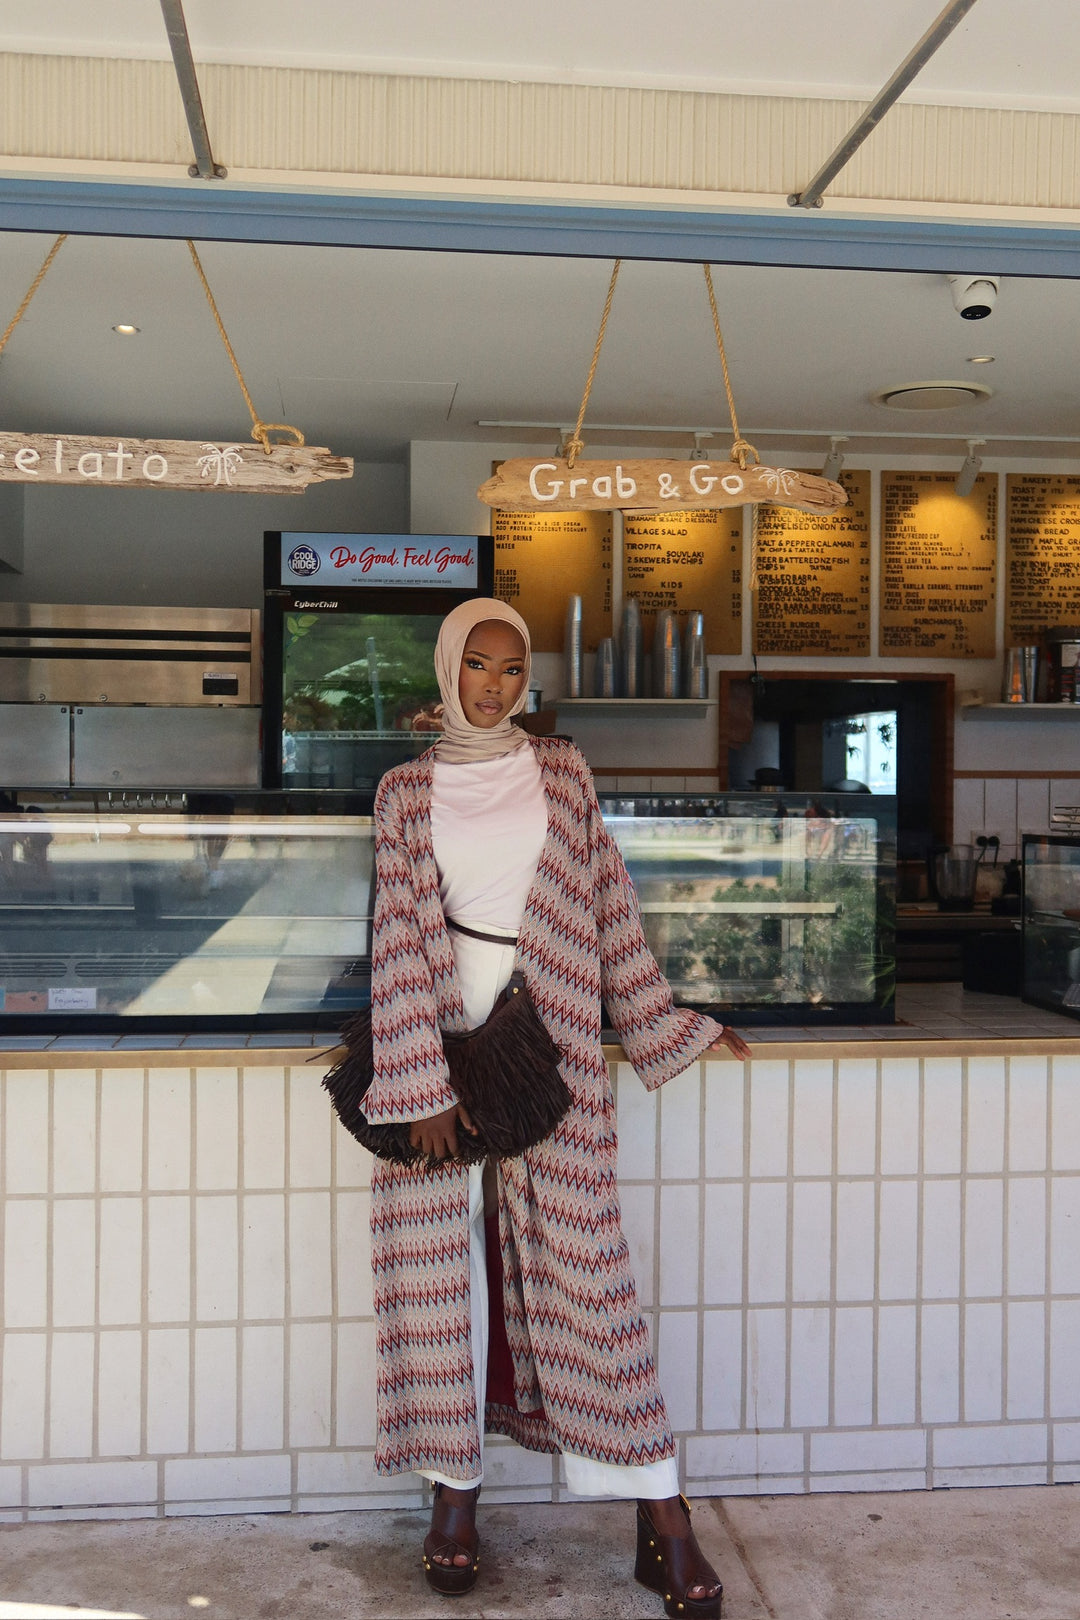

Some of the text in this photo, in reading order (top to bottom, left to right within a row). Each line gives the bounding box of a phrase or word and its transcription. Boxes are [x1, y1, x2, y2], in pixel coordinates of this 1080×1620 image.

[0, 440, 168, 480] elato
[529, 463, 744, 501] Grab & Go
[1011, 486, 1035, 494] TOAST
[795, 516, 828, 524] TOMATO
[625, 527, 660, 535] VILLAGE
[811, 523, 836, 531] ONION
[816, 540, 855, 548] CALAMARI
[294, 552, 315, 560] COOL
[329, 546, 357, 569] Do
[358, 546, 399, 573] Good.
[403, 547, 433, 567] Feel
[292, 560, 317, 570] RIDGE
[796, 586, 822, 594] SALAD
[294, 600, 338, 609] CyberChill
